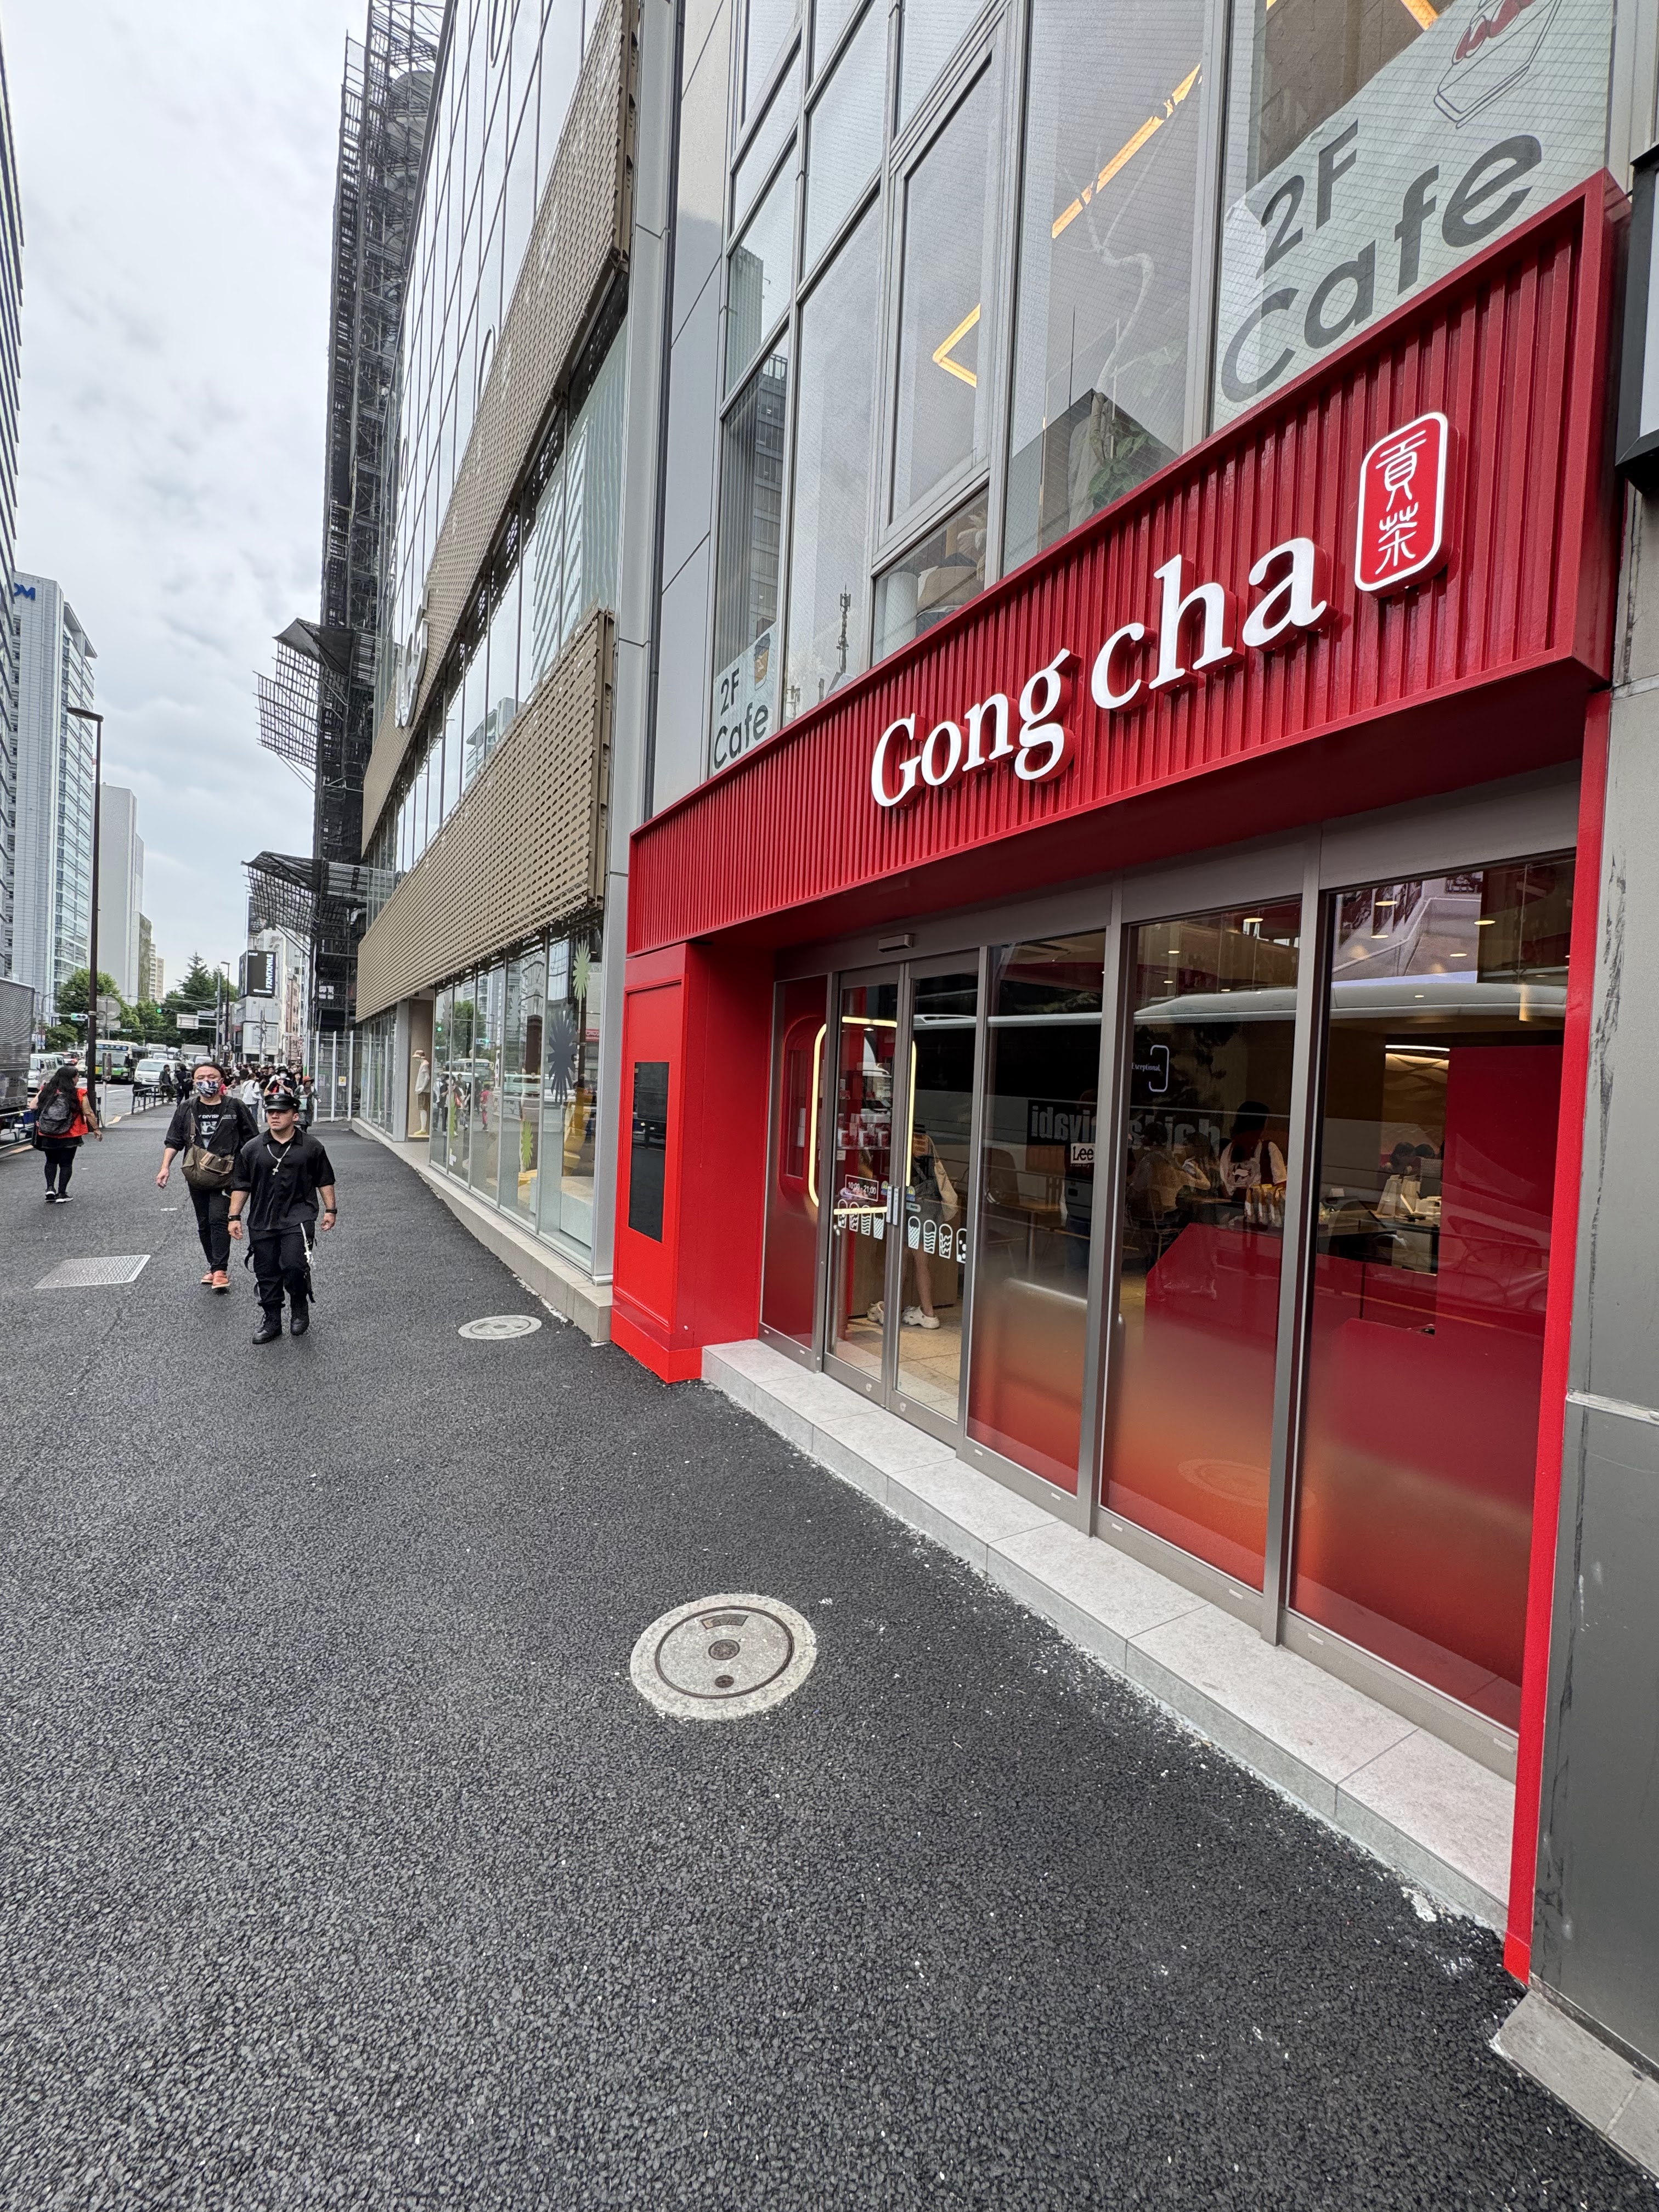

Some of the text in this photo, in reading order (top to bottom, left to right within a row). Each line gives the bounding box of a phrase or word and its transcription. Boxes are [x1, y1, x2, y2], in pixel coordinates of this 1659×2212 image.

[1257, 119, 1359, 278] 2F
[1375, 430, 1427, 574] 貢茶
[721, 668, 739, 716] 2F
[871, 537, 1329, 808] Gong cha
[714, 702, 769, 770] Cafe
[1073, 1146, 1094, 1161] Lee
[864, 1185, 876, 1194] 21:00
